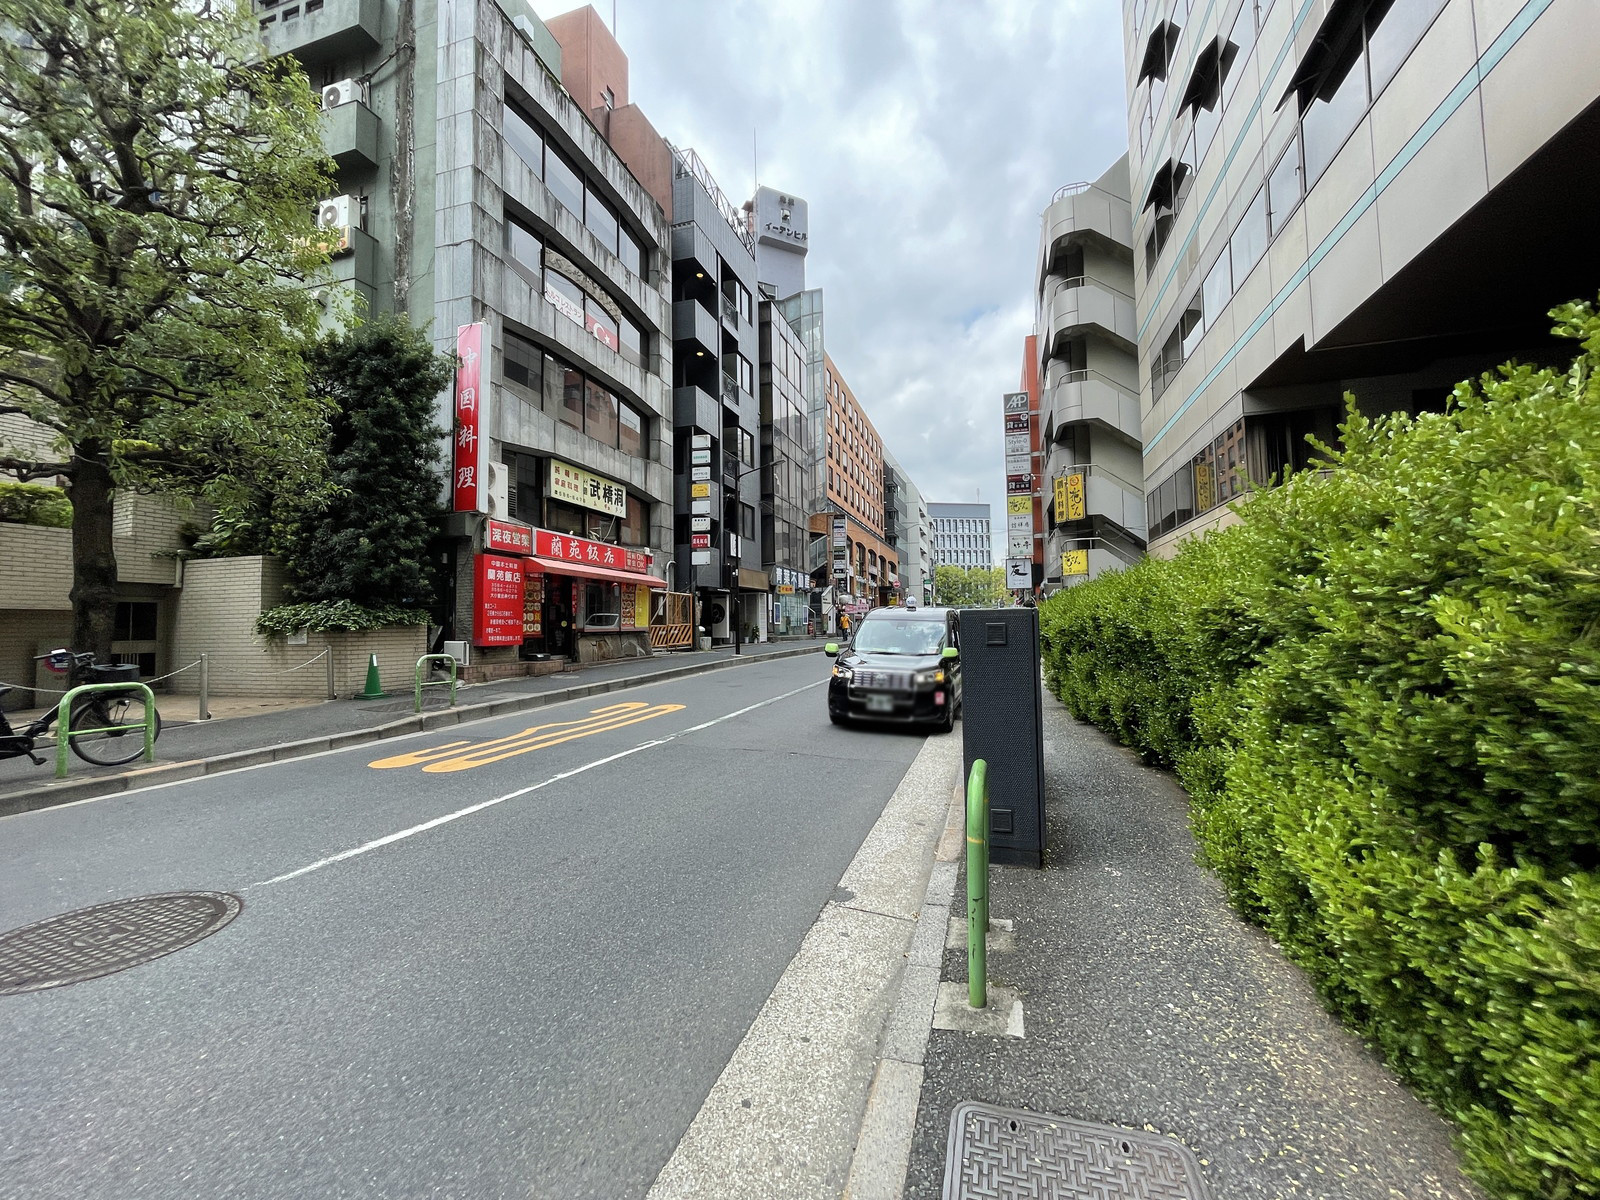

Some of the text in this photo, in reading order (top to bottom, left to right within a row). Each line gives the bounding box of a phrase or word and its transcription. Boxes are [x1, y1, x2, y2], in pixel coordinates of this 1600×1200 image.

[456, 346, 479, 489] 中国料理
[491, 527, 530, 547] 深夜営業
[551, 536, 615, 565] 蘭苑飯店
[487, 569, 521, 583] 蘭苑飯店
[367, 702, 687, 773] 30
